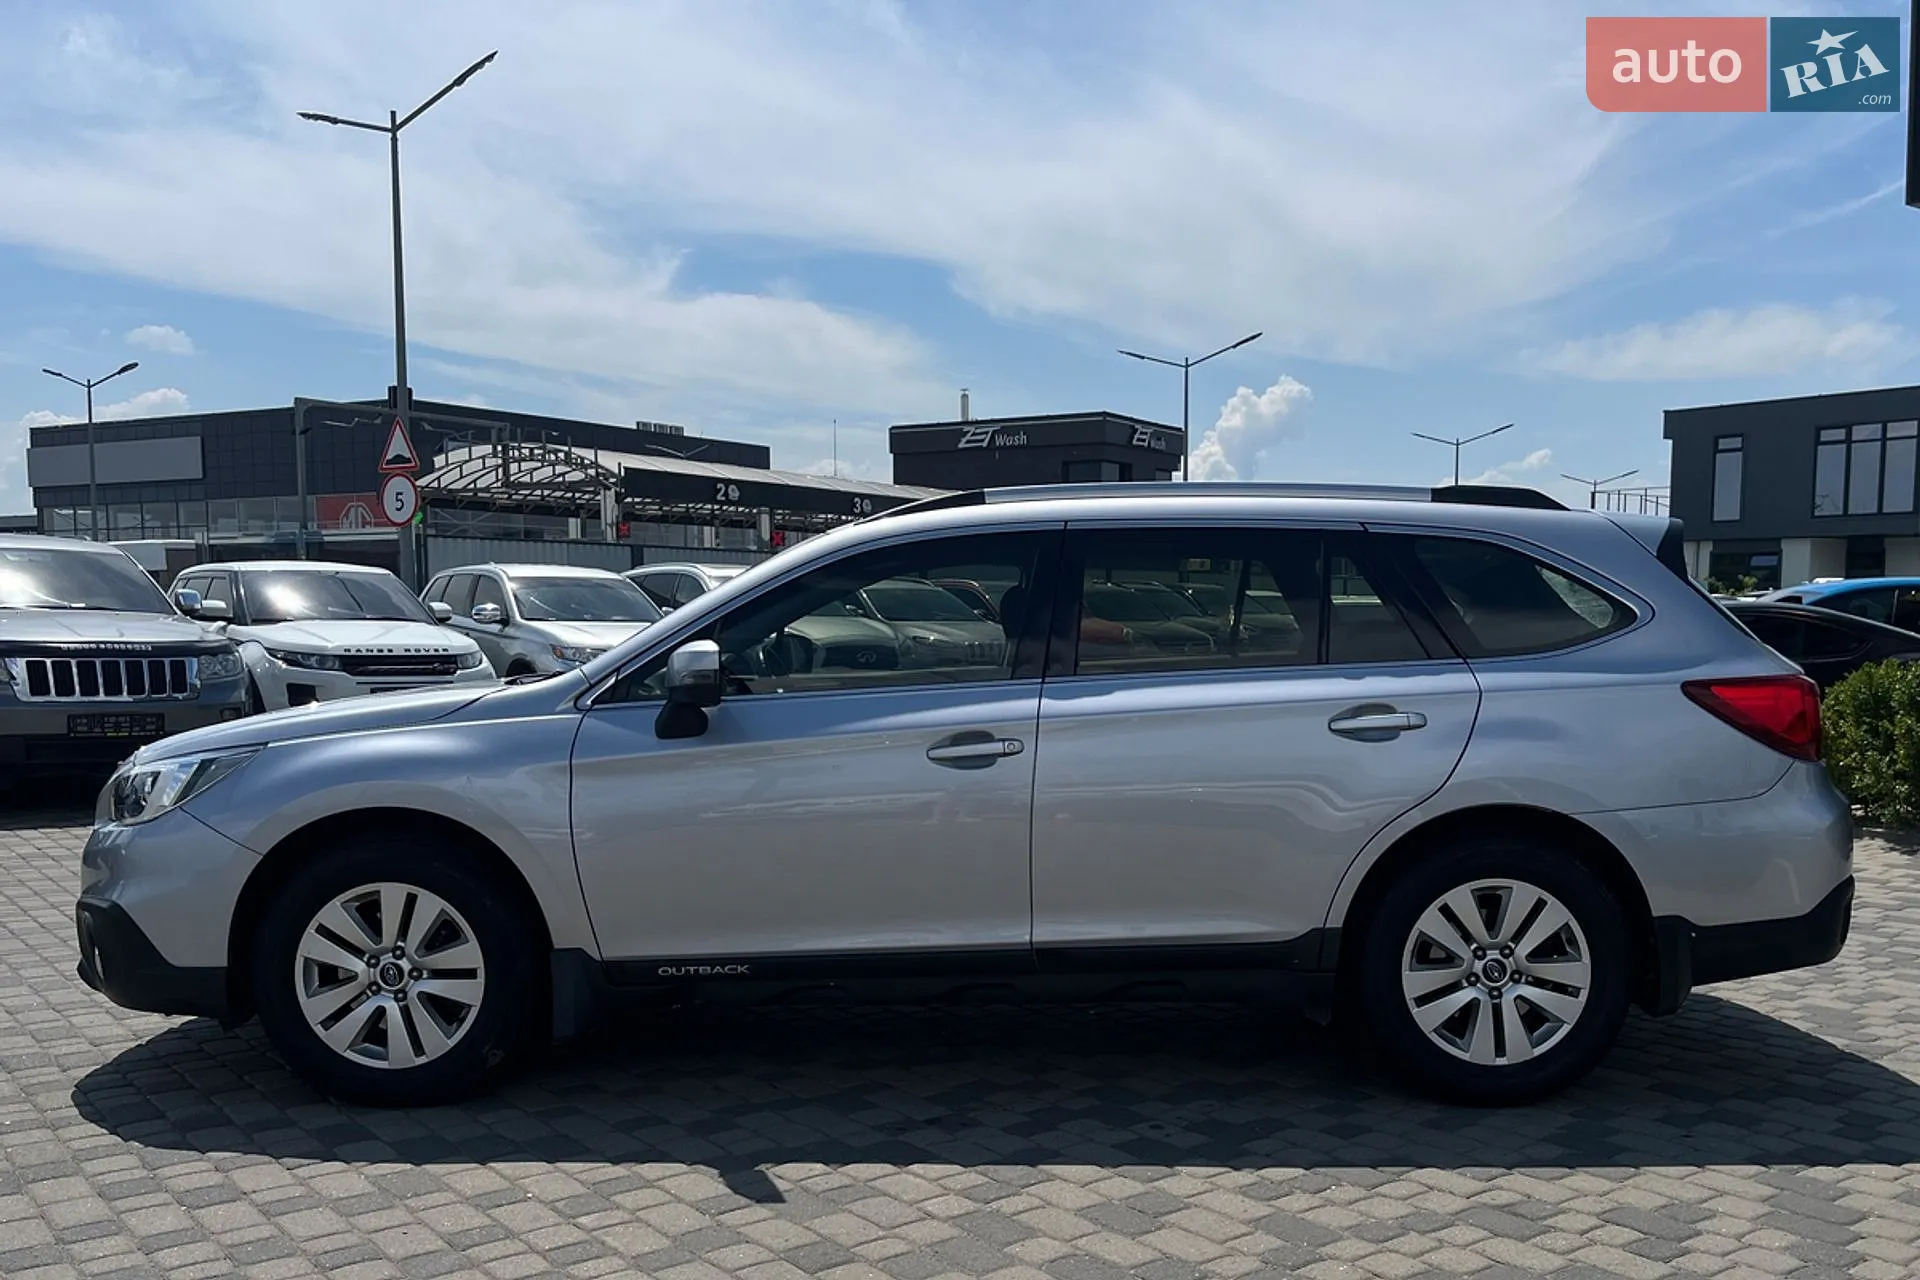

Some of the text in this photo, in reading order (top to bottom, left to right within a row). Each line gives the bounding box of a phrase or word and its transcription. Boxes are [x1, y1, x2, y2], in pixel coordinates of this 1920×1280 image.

[995, 431, 1027, 447] Wash
[716, 483, 726, 501] 2
[395, 491, 404, 512] 5
[853, 497, 861, 513] 3
[658, 964, 750, 976] OUTBACK
